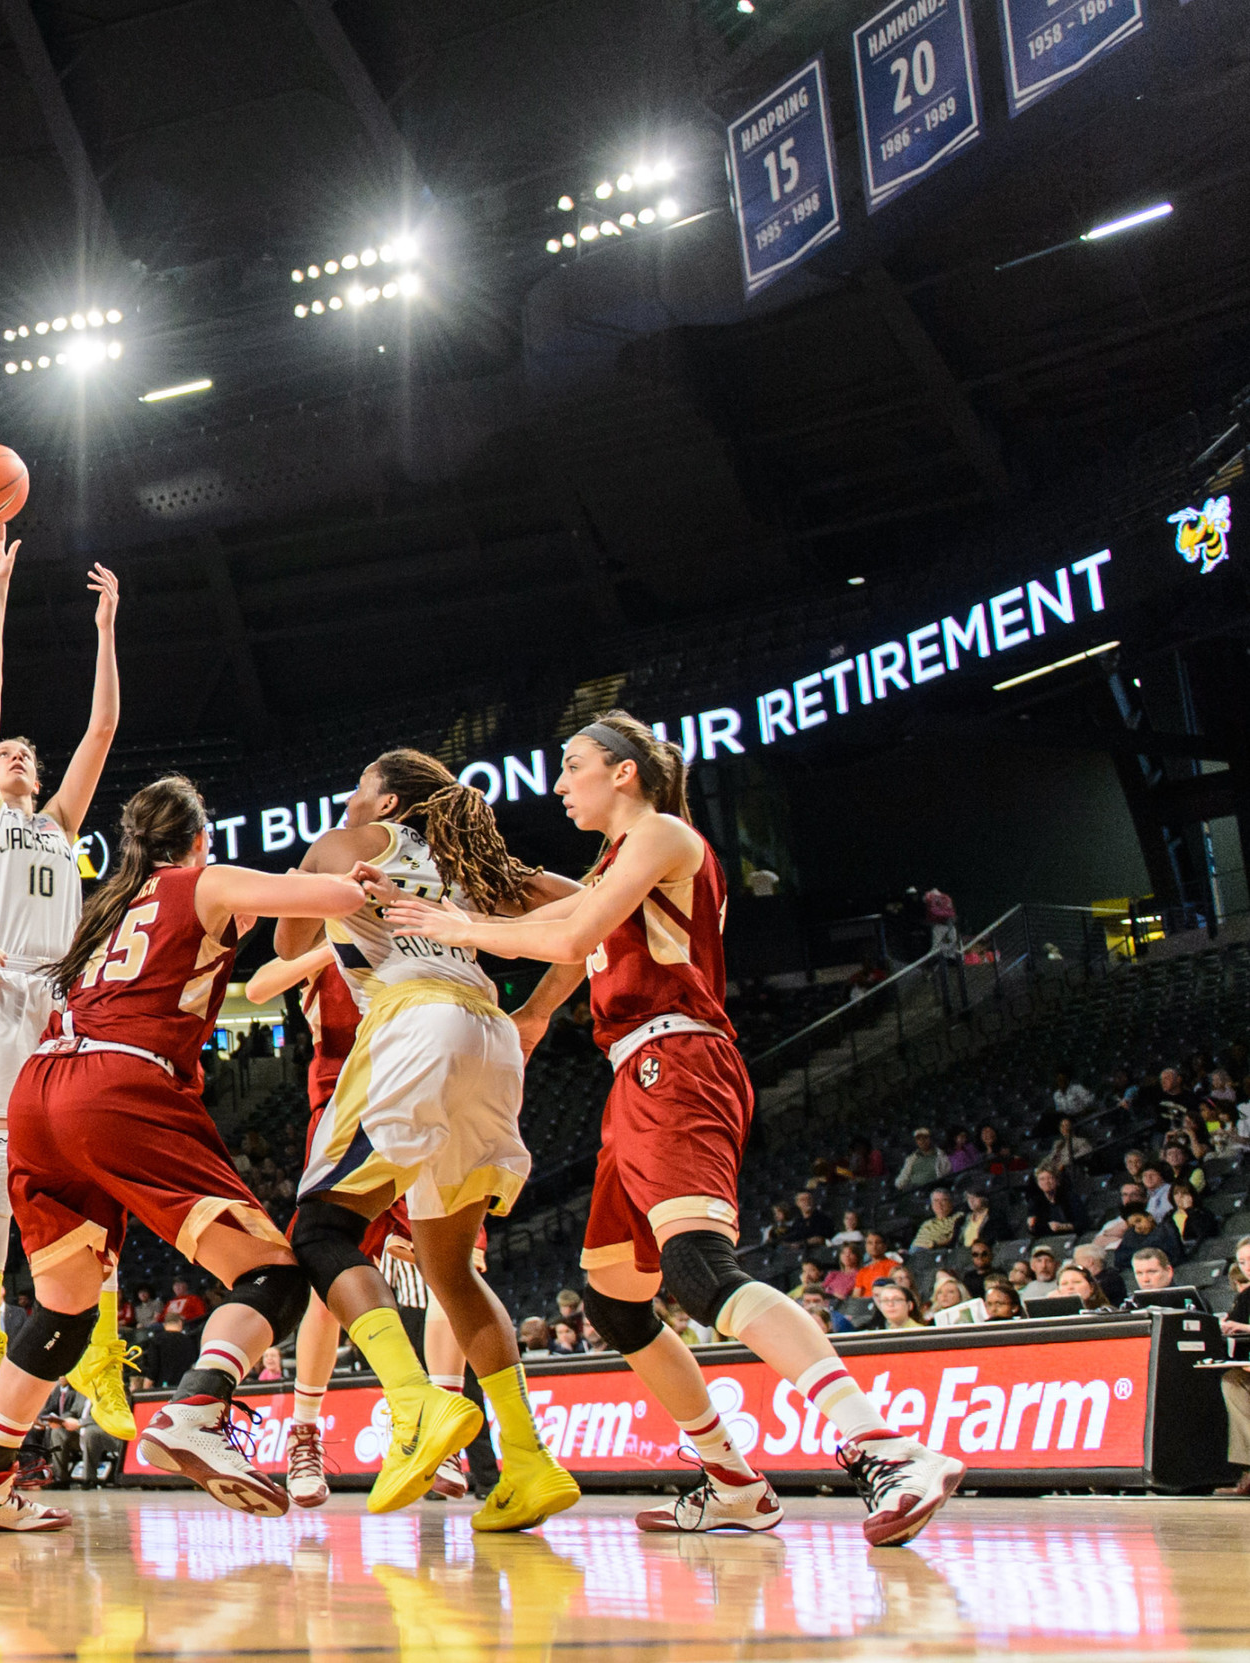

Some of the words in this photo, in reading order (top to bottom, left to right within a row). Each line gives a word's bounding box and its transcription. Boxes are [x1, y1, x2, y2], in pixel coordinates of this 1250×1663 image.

[1027, 23, 1063, 60] 1958
[890, 40, 936, 115] 20
[741, 86, 810, 153] HARPRING
[880, 127, 911, 161] 1986
[924, 96, 956, 131] 1989
[763, 136, 800, 203] 15
[754, 219, 783, 251] 1995
[792, 192, 820, 225] 1998
[458, 750, 547, 806] ON
[757, 549, 1111, 744] RETIREMENT
[401, 827, 427, 847] ACC
[29, 864, 54, 898] 10
